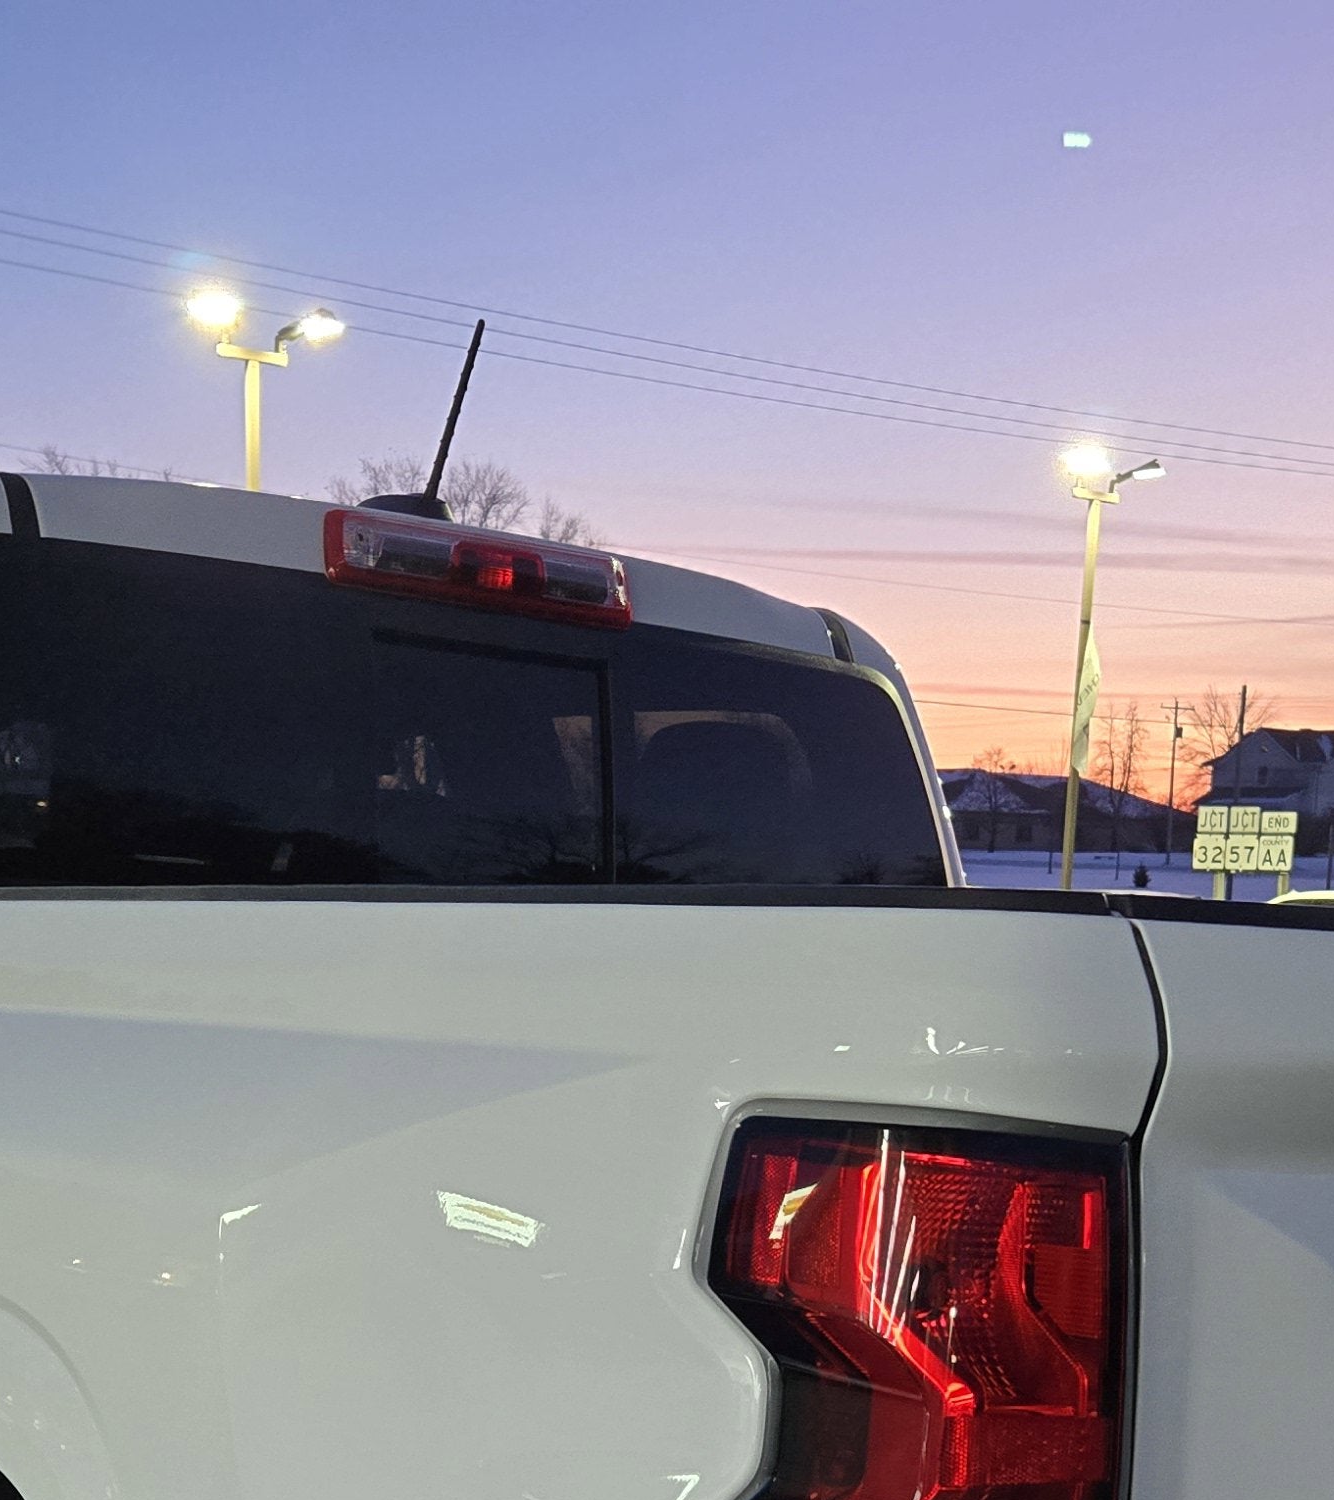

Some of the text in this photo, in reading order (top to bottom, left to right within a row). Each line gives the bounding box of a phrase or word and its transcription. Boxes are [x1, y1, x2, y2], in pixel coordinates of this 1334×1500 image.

[1200, 811, 1225, 829] JCT
[1232, 811, 1258, 829] JCT
[1267, 816, 1290, 829] END
[1197, 845, 1223, 864] 32
[1229, 845, 1255, 864] 57
[1261, 848, 1287, 867] AA
